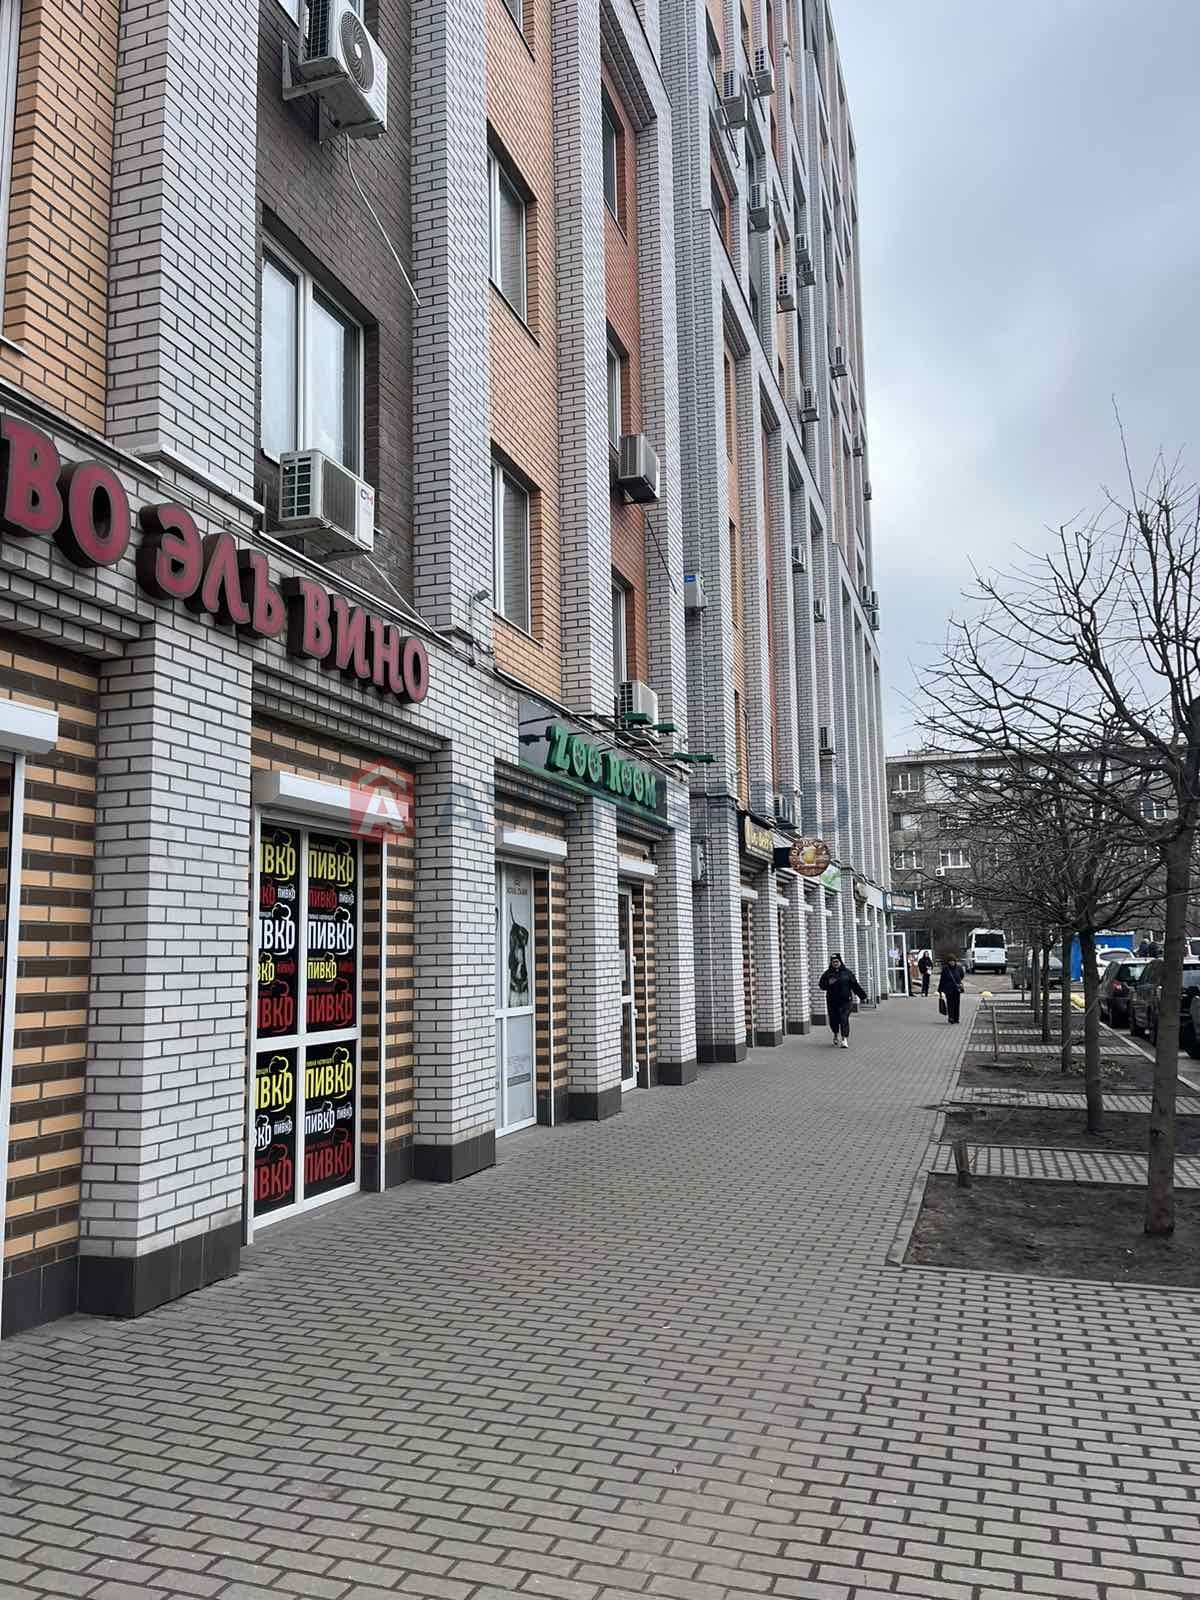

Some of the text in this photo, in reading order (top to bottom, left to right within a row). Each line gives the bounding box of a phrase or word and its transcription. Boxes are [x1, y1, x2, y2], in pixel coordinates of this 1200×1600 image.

[293, 576, 430, 703] ВИНО
[548, 724, 657, 809] ZOO ROOM
[308, 849, 355, 883] ПИВКО
[308, 920, 354, 951] ПИВКО
[307, 961, 337, 981] ПИВКО
[306, 993, 354, 1024] ПИВКО
[304, 1062, 353, 1100] ПИВКО
[304, 1109, 335, 1135] ПИВКО
[304, 1142, 353, 1185] ПИВКО
